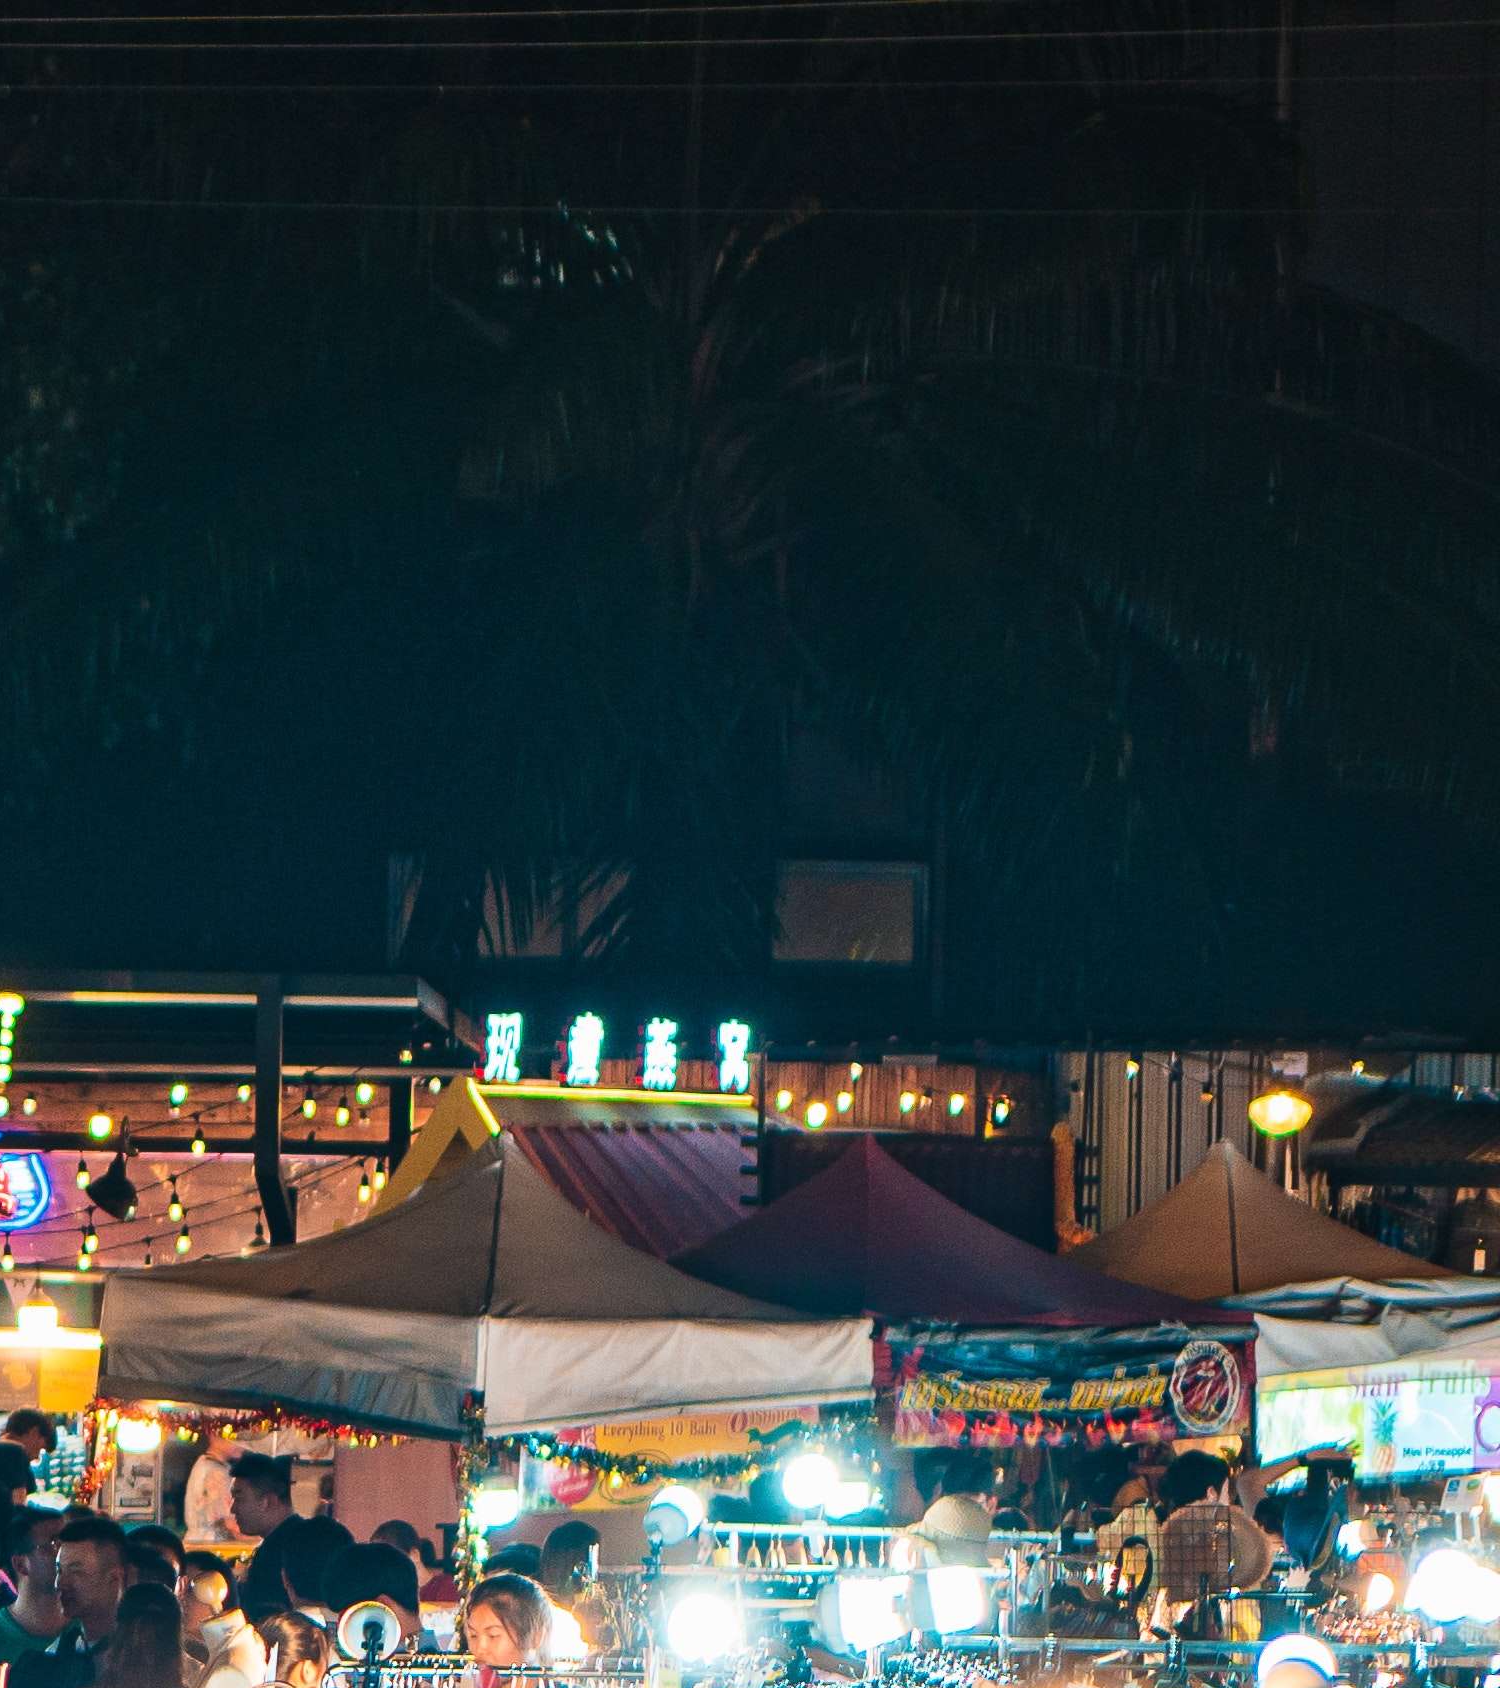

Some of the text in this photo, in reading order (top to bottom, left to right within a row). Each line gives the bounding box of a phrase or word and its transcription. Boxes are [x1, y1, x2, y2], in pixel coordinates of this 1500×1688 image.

[603, 1423, 665, 1441] Everything
[670, 1422, 684, 1436] 10
[690, 1422, 717, 1436] Baht
